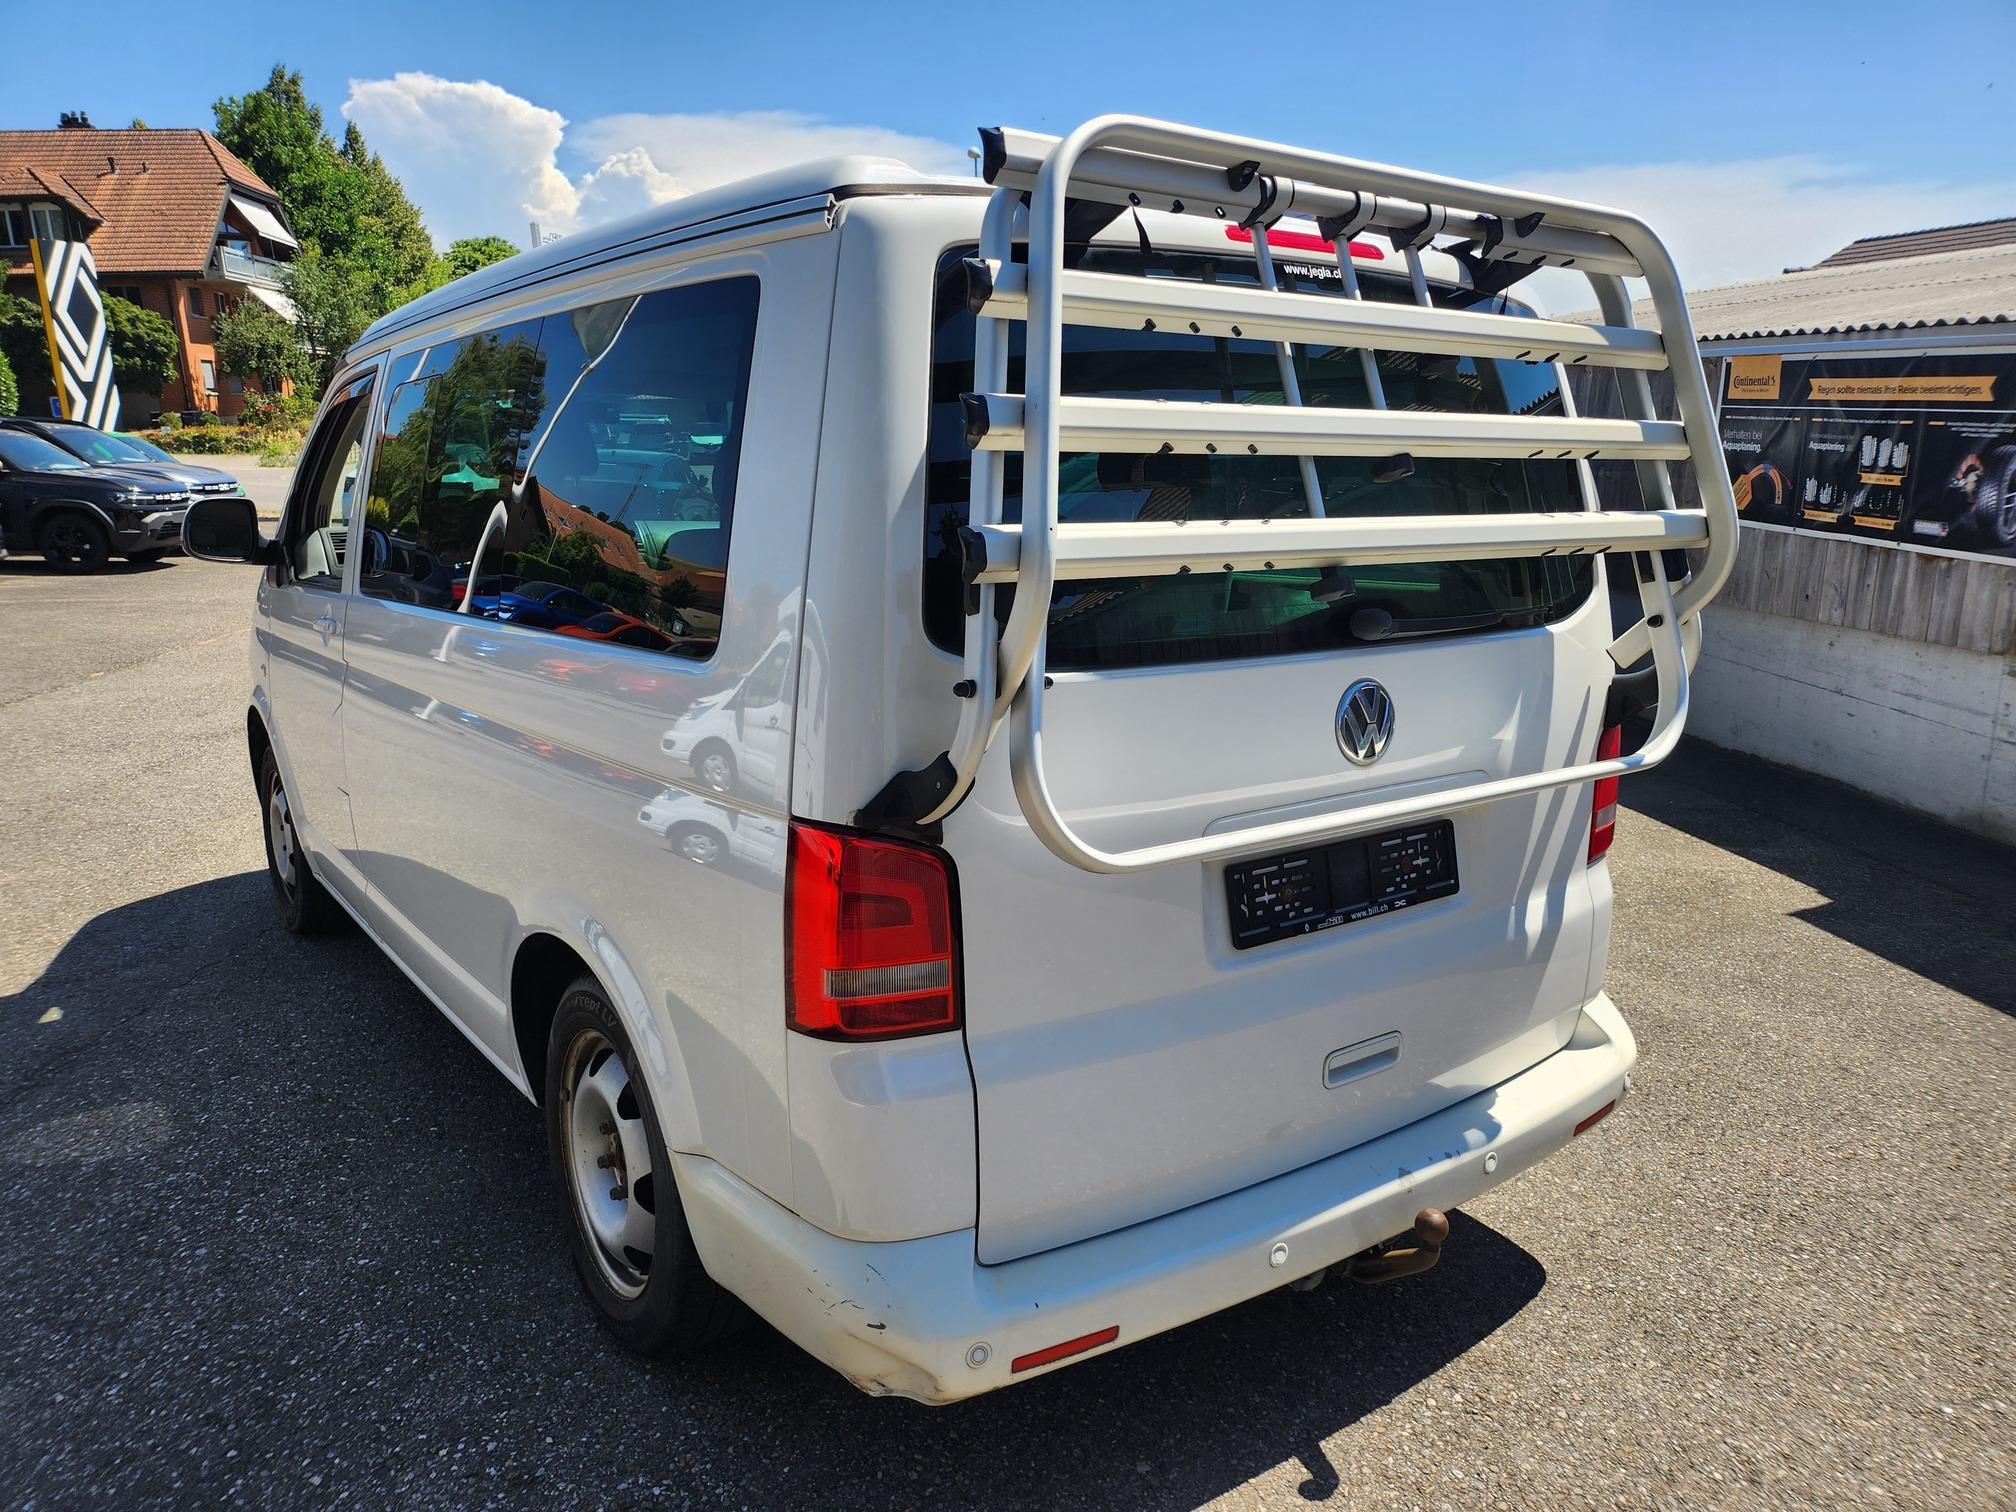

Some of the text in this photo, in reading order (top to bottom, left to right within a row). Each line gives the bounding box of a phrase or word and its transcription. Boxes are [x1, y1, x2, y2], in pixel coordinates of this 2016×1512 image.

[1734, 376, 1770, 389] Continental
[1818, 385, 1836, 395] Regen
[1837, 385, 1855, 394] sollte
[1857, 385, 1882, 394] niemals
[1898, 385, 1919, 394] Reise
[1724, 429, 1763, 440] Verhalten bei
[1722, 440, 1762, 453] Aquaplaning.
[1808, 441, 1845, 453] Aquaplaning
[1351, 903, 1389, 920] www.bill.ch
